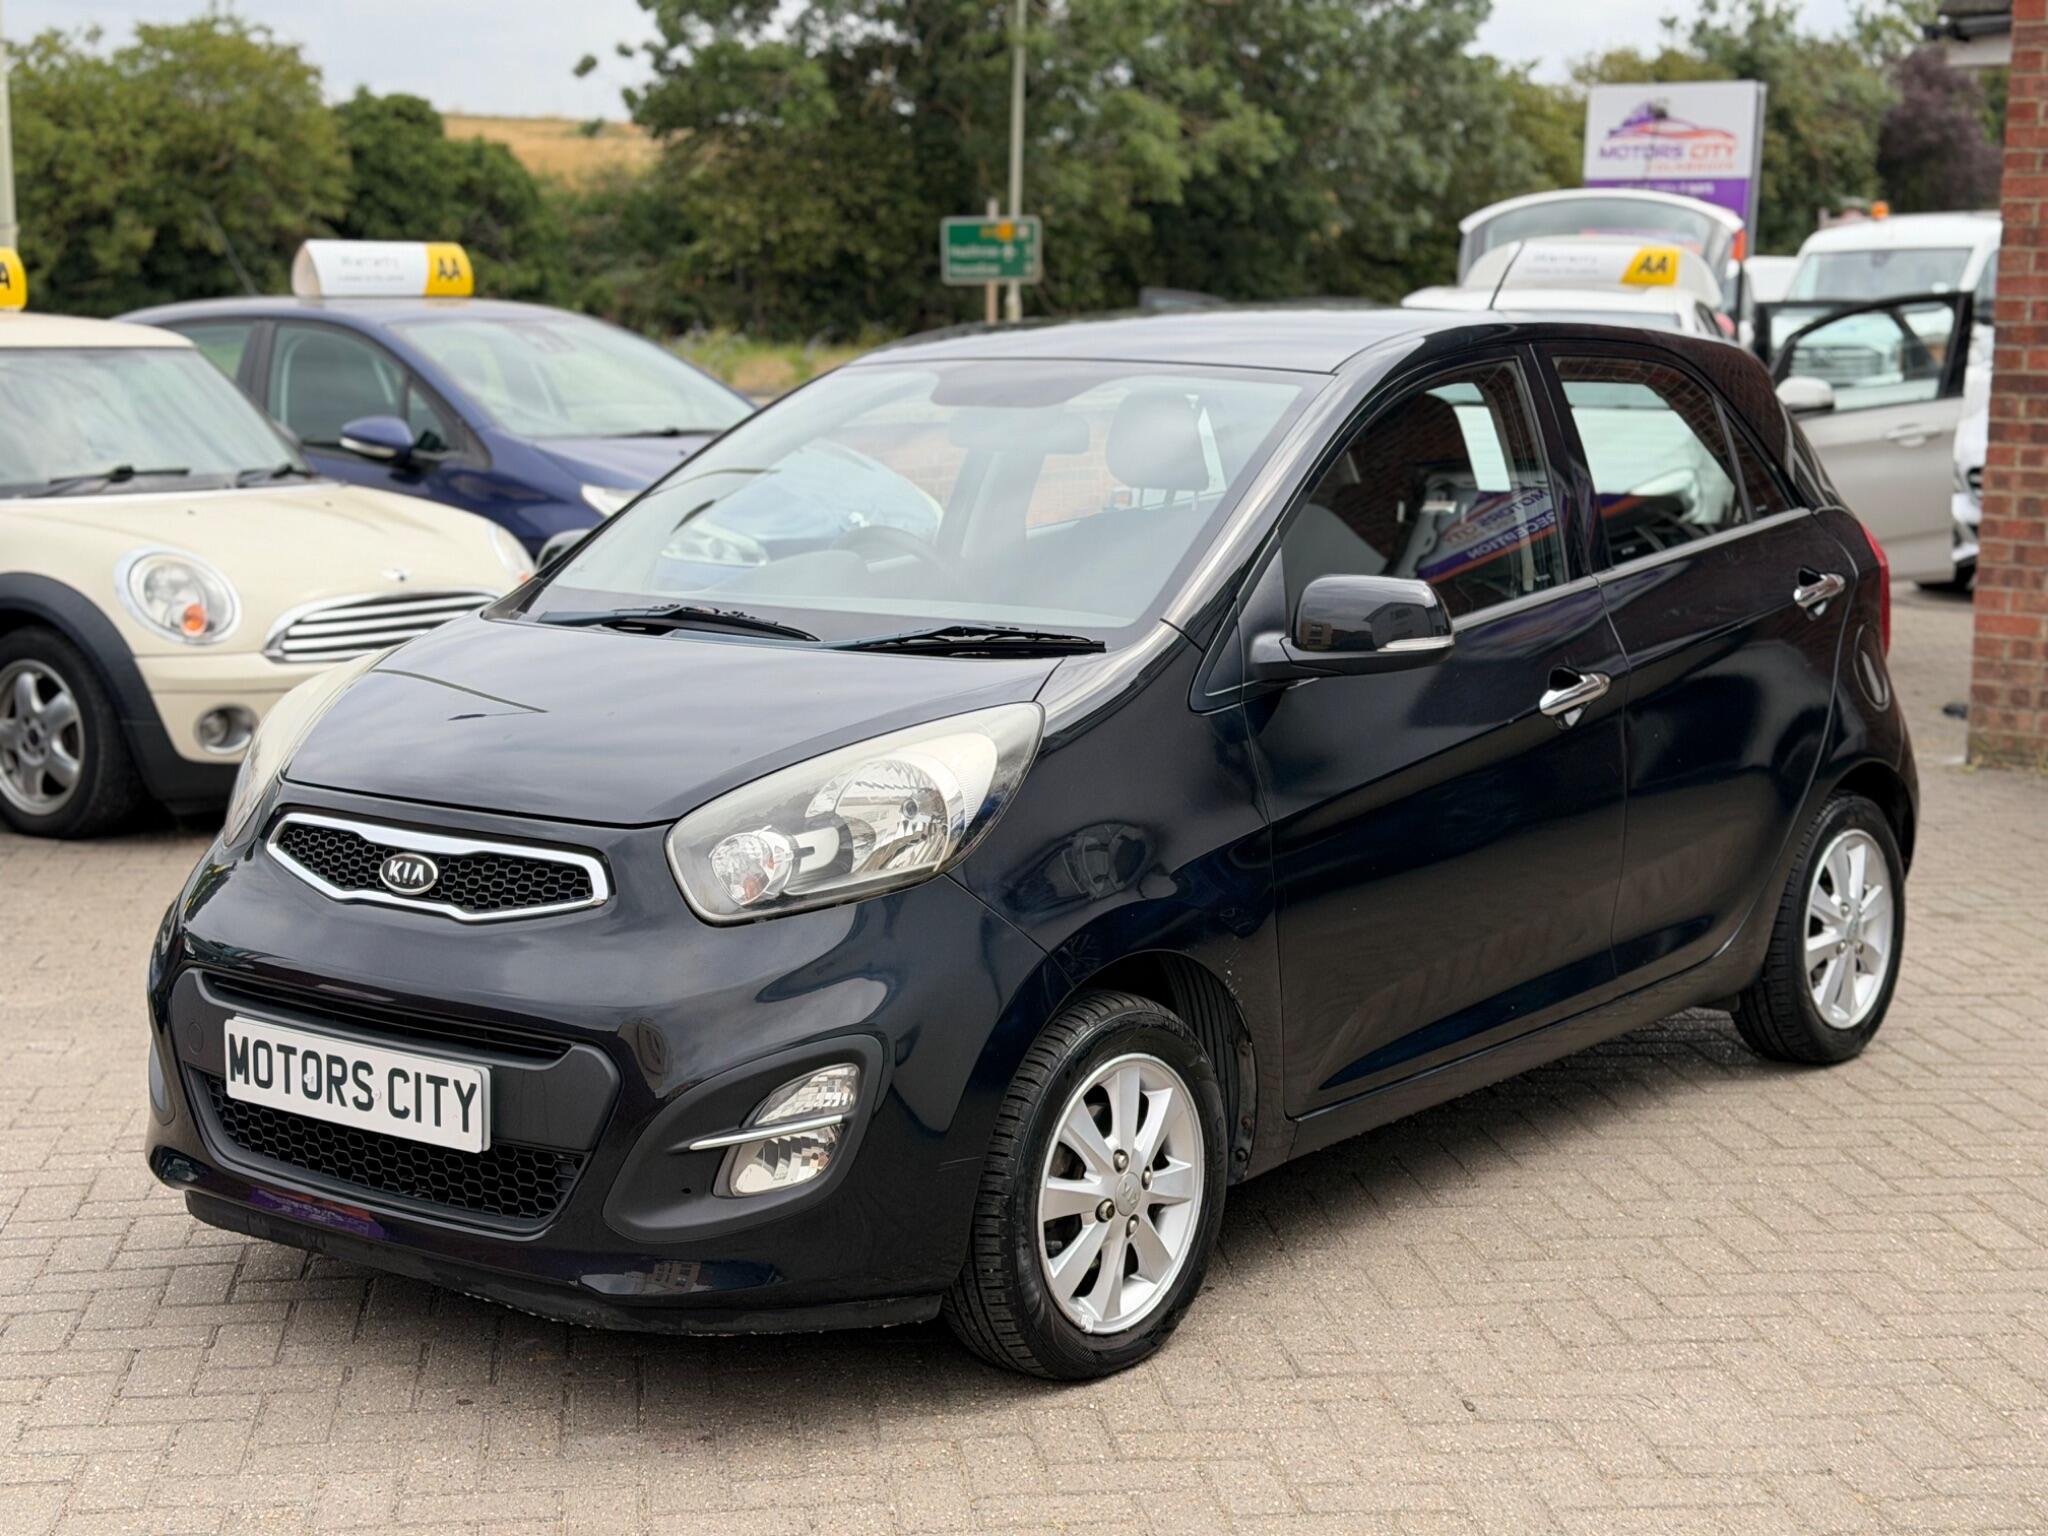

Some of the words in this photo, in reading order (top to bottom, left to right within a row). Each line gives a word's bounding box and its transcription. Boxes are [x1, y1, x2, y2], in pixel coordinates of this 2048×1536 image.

[1599, 145, 1683, 160] MOTORS
[1690, 143, 1735, 158] CITY
[436, 258, 462, 281] AA
[1640, 256, 1667, 273] AA
[388, 860, 424, 885] KIA
[229, 1033, 374, 1111] MOTORS
[388, 1067, 477, 1132] CITY
